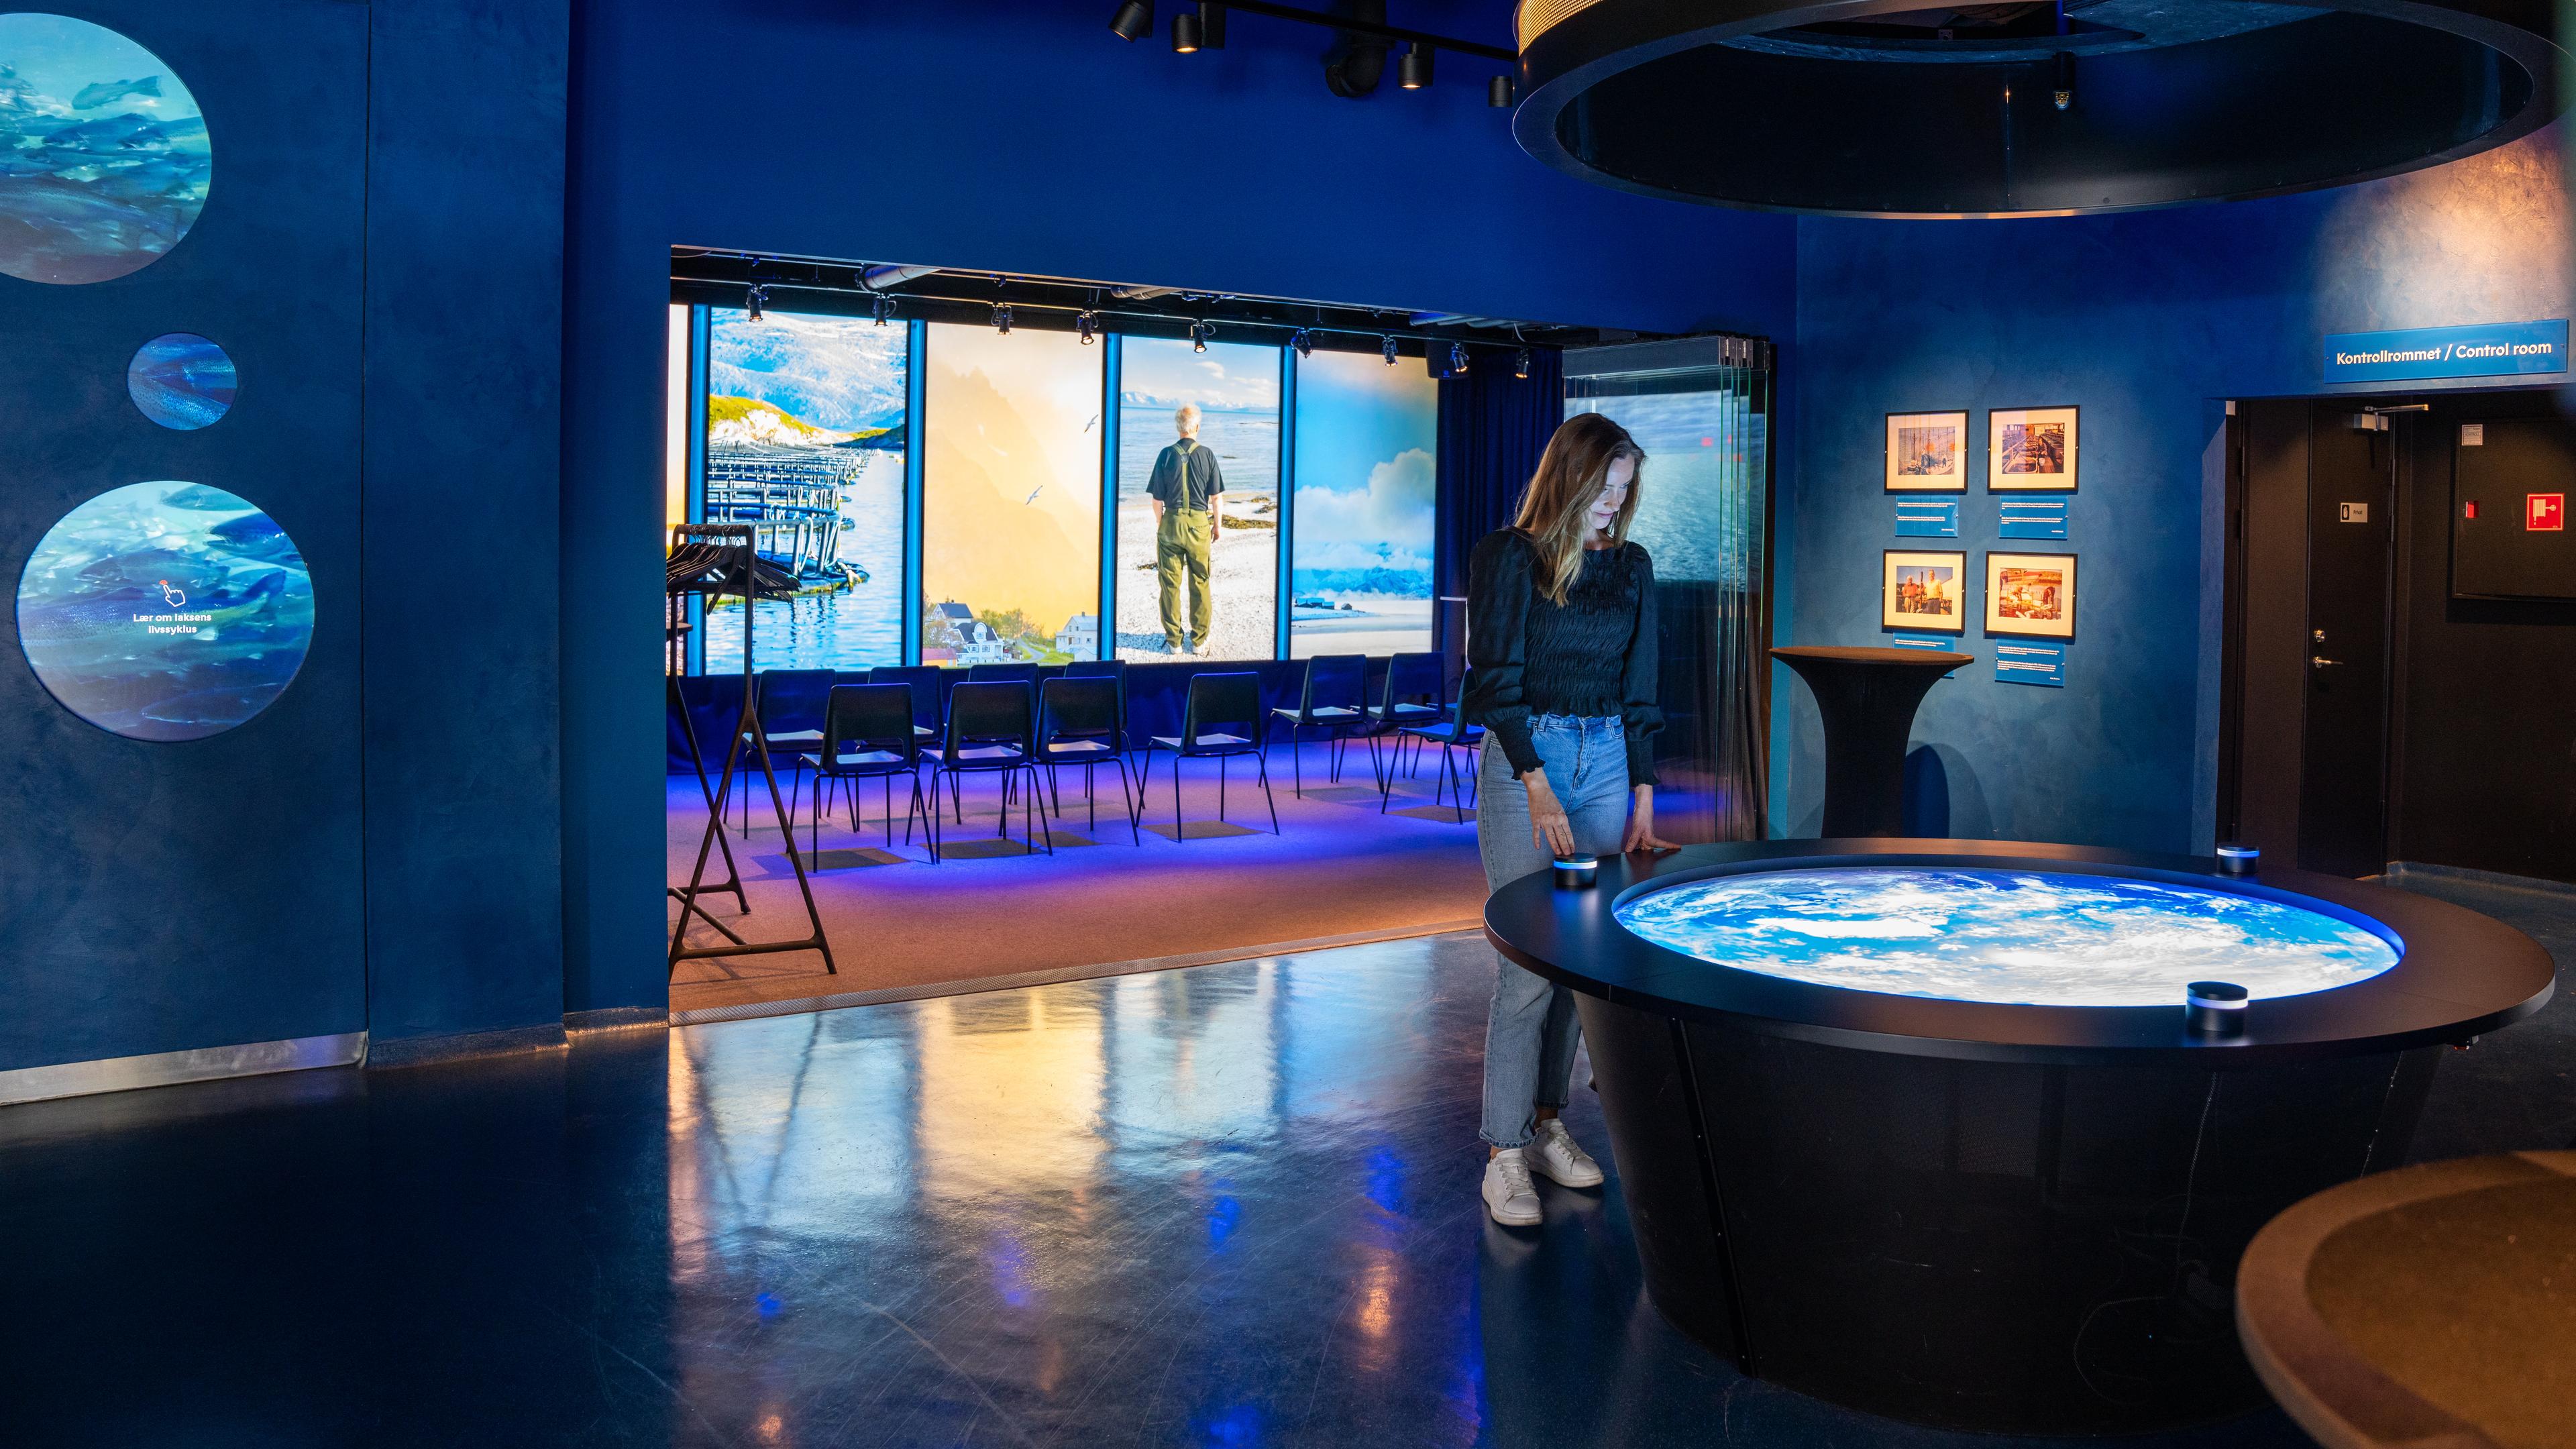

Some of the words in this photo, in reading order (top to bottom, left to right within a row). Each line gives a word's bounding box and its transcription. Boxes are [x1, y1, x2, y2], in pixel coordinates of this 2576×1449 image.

[2337, 347, 2440, 365] Kontrollrommet
[2445, 343, 2453, 361] /
[2456, 343, 2509, 358] Control
[2513, 343, 2552, 355] room
[133, 614, 153, 622] Lær
[174, 613, 212, 622] laksens
[148, 625, 197, 635] livssyklus
